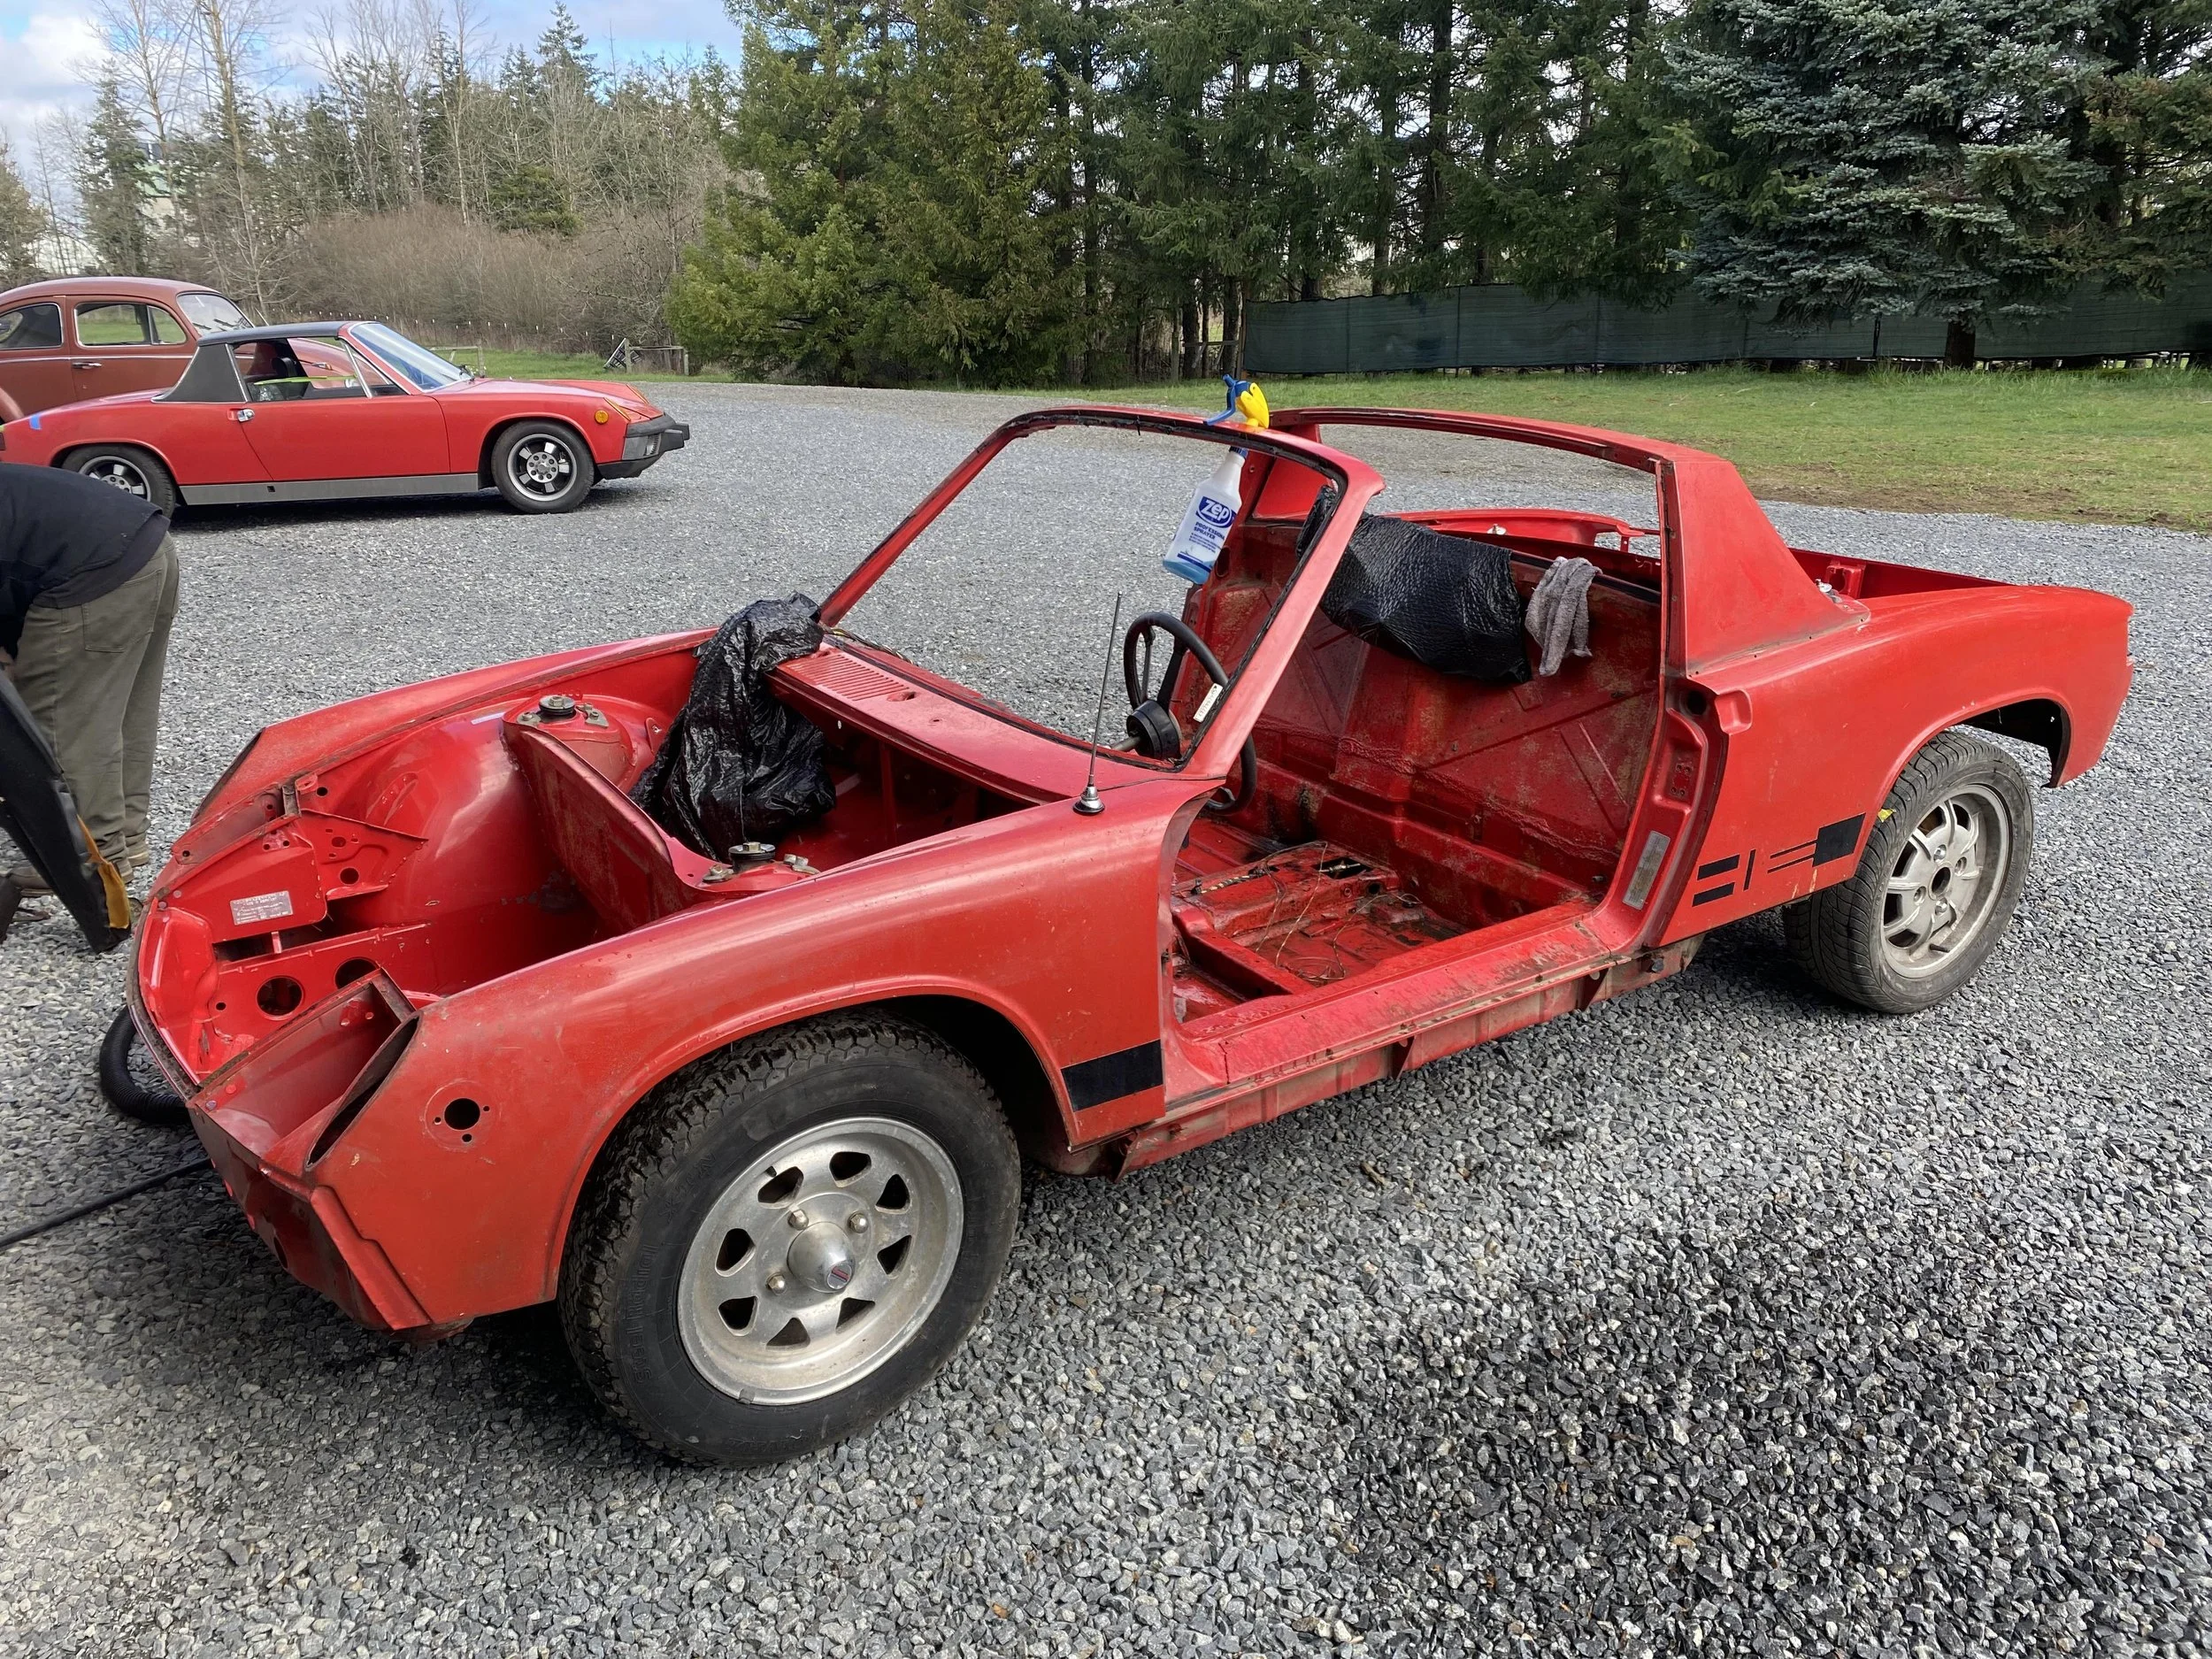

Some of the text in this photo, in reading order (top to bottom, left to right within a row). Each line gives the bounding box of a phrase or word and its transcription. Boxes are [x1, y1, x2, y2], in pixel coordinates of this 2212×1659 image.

[1194, 526, 1216, 540] SPRAYER
[1195, 522, 1225, 541] PROFESSIONA
[626, 1325, 652, 1384] Steel
